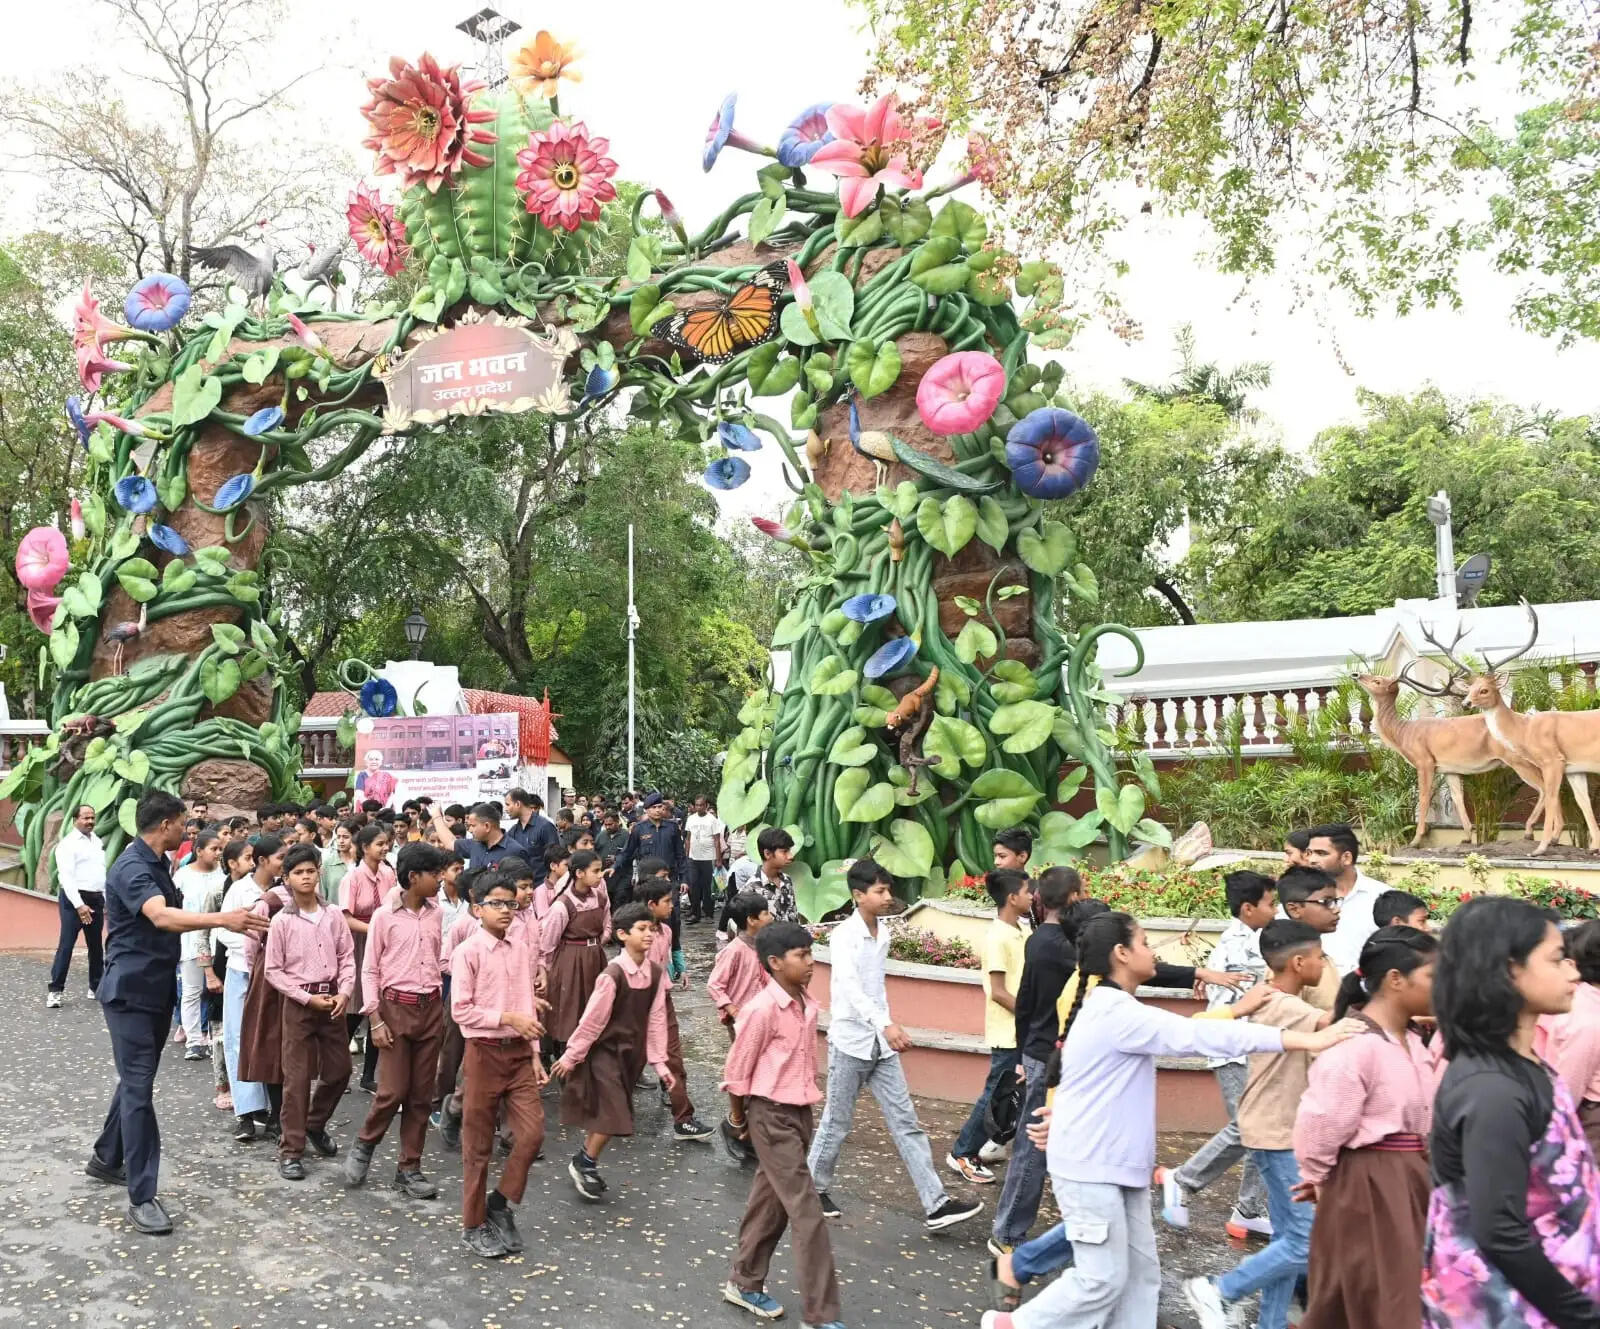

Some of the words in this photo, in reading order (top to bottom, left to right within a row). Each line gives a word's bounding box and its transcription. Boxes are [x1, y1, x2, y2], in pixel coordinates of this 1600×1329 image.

[417, 360, 464, 384] जन
[468, 352, 528, 377] भवन
[432, 386, 473, 401] उत्तर
[475, 380, 513, 396] प्रदेश
